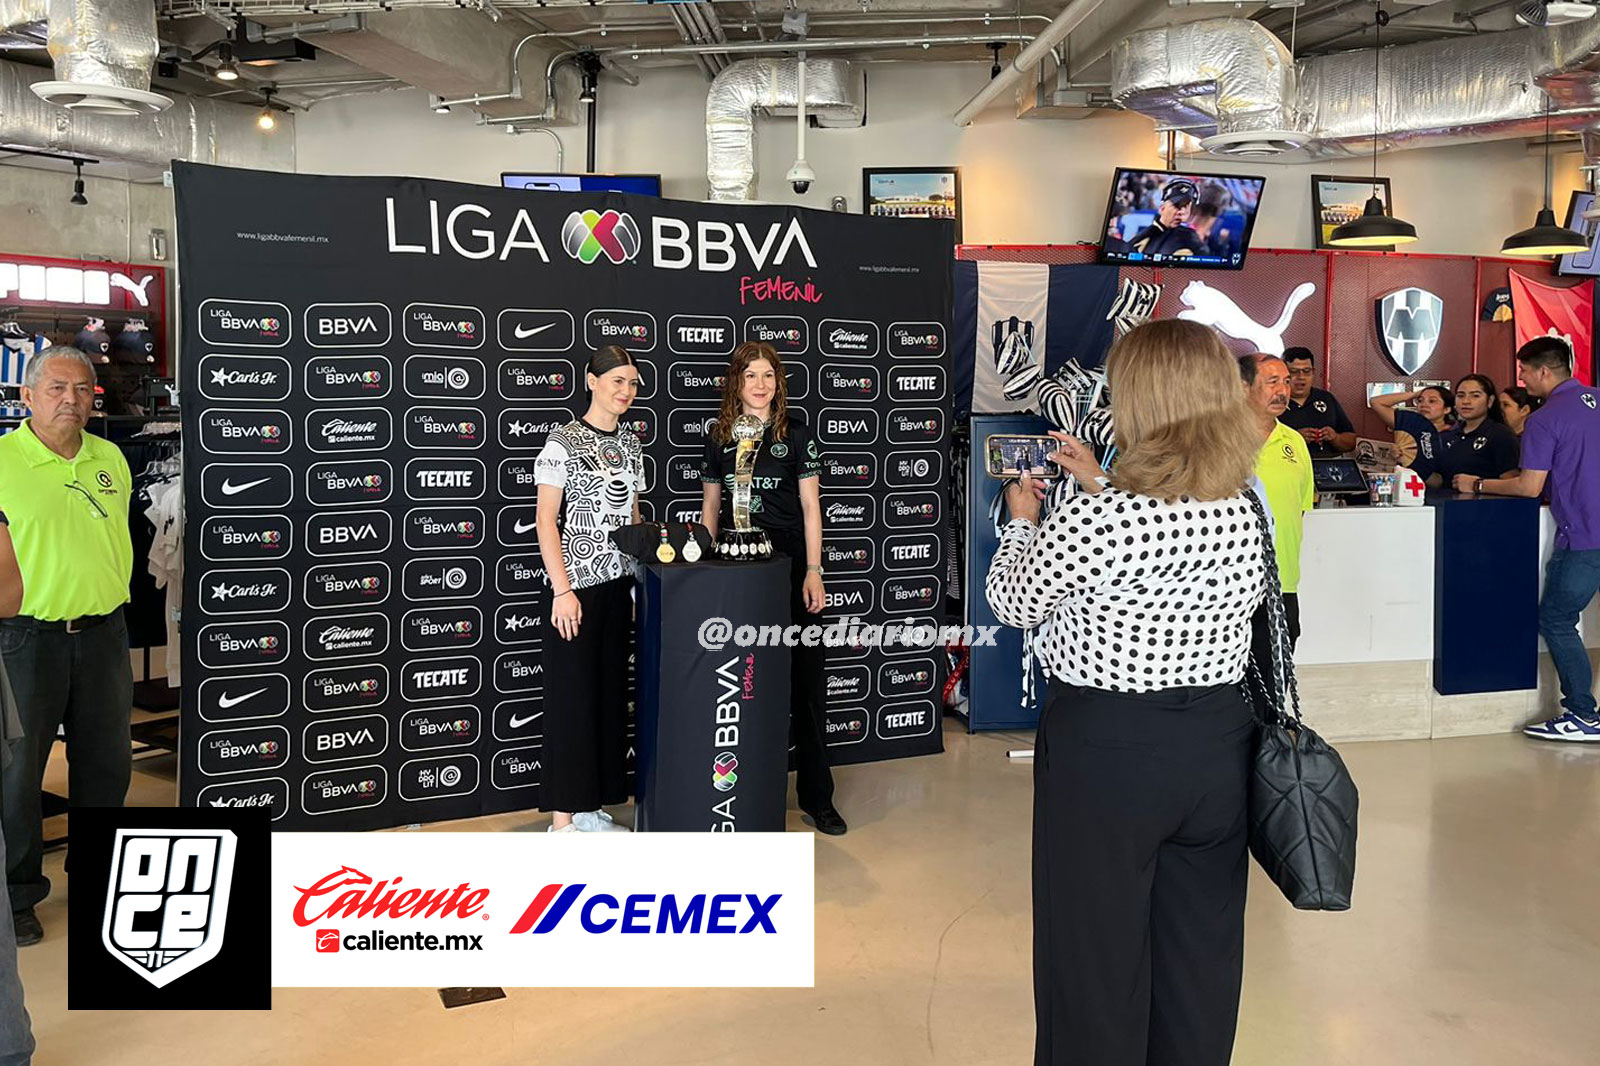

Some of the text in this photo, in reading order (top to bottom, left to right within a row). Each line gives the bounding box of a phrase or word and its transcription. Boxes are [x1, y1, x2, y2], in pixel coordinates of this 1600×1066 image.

[386, 198, 819, 271] LIGA BBVA
[210, 309, 232, 318] LIGA
[413, 312, 433, 321] LIGA
[221, 317, 260, 330] BBVA
[319, 316, 378, 335] BBVA
[423, 320, 458, 332] BBVA
[593, 318, 611, 326] LIGA
[601, 325, 633, 336] BBVA
[677, 326, 725, 343] TECATE
[759, 330, 787, 340] BBVA
[900, 335, 926, 346] BBVA
[315, 366, 336, 374] LIGA
[507, 368, 526, 376] LIGA
[227, 370, 261, 385] Carl's
[325, 372, 362, 385] BBVA
[516, 374, 549, 386] BBVA
[684, 377, 713, 387] BBVA
[833, 377, 859, 388] BBVA
[896, 376, 937, 391] TECATE
[210, 418, 233, 427] LIGA
[414, 415, 433, 424] LIGA
[321, 418, 377, 437] Caliente
[423, 422, 458, 435] BBVA
[827, 420, 869, 434] BBVA
[900, 421, 925, 432] BBVA
[221, 426, 261, 439] BBVA
[823, 459, 839, 467] LIGA
[317, 471, 338, 480] LIGA
[683, 470, 700, 479] BB
[830, 465, 856, 476] BBVA
[327, 477, 363, 490] BBVA
[416, 470, 473, 487] TECATE
[516, 473, 535, 484] BB
[896, 506, 922, 516] BBVA
[414, 516, 433, 525] LIGA
[600, 513, 630, 527] AT&T
[212, 525, 235, 534] LIGA
[319, 523, 378, 544] BBVA
[423, 522, 457, 535] BBVA
[222, 532, 261, 545] BBVA
[828, 550, 854, 561] BBVA
[891, 544, 931, 560] TECATE
[505, 563, 524, 572] LIGA
[315, 574, 336, 583] LIGA
[325, 579, 361, 592] BBVA
[227, 584, 262, 599] Carl's
[895, 589, 920, 600] BBVA
[411, 617, 431, 626] LIGA
[420, 622, 455, 635] BBVA
[209, 633, 231, 642] LIGA
[319, 625, 375, 645] Caliente
[219, 639, 259, 652] BBVA
[503, 660, 522, 669] LIGA
[314, 677, 335, 686] LIGA
[412, 668, 469, 688] TECATE
[891, 673, 916, 684] BBVA
[323, 683, 360, 697] BBVA
[715, 655, 741, 748] BBVA
[410, 717, 430, 726] LIGA
[885, 710, 926, 729] TECATE
[418, 722, 453, 736] BBVA
[210, 740, 232, 748] LIGA
[316, 728, 375, 751] BBVA
[220, 746, 259, 759] BBVA
[501, 757, 519, 766] LIGA
[313, 780, 333, 790] LIGA
[322, 785, 359, 799] BBVA
